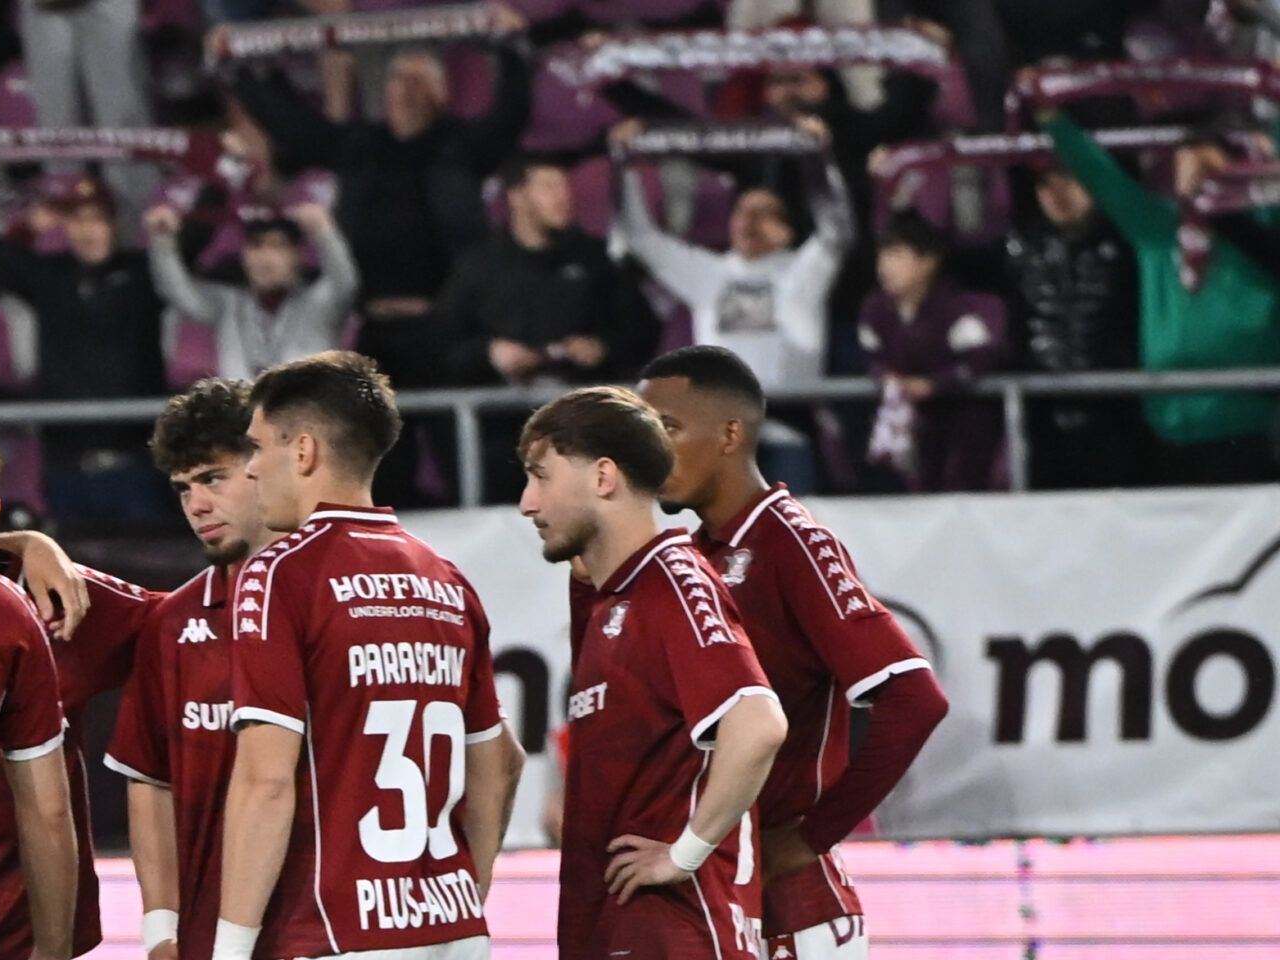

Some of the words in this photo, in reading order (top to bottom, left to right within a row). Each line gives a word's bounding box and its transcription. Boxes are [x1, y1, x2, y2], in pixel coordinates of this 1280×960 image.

[328, 573, 466, 612] HOFFMAN
[348, 605, 424, 618] UNDERFLOOR
[358, 700, 466, 863] 30
